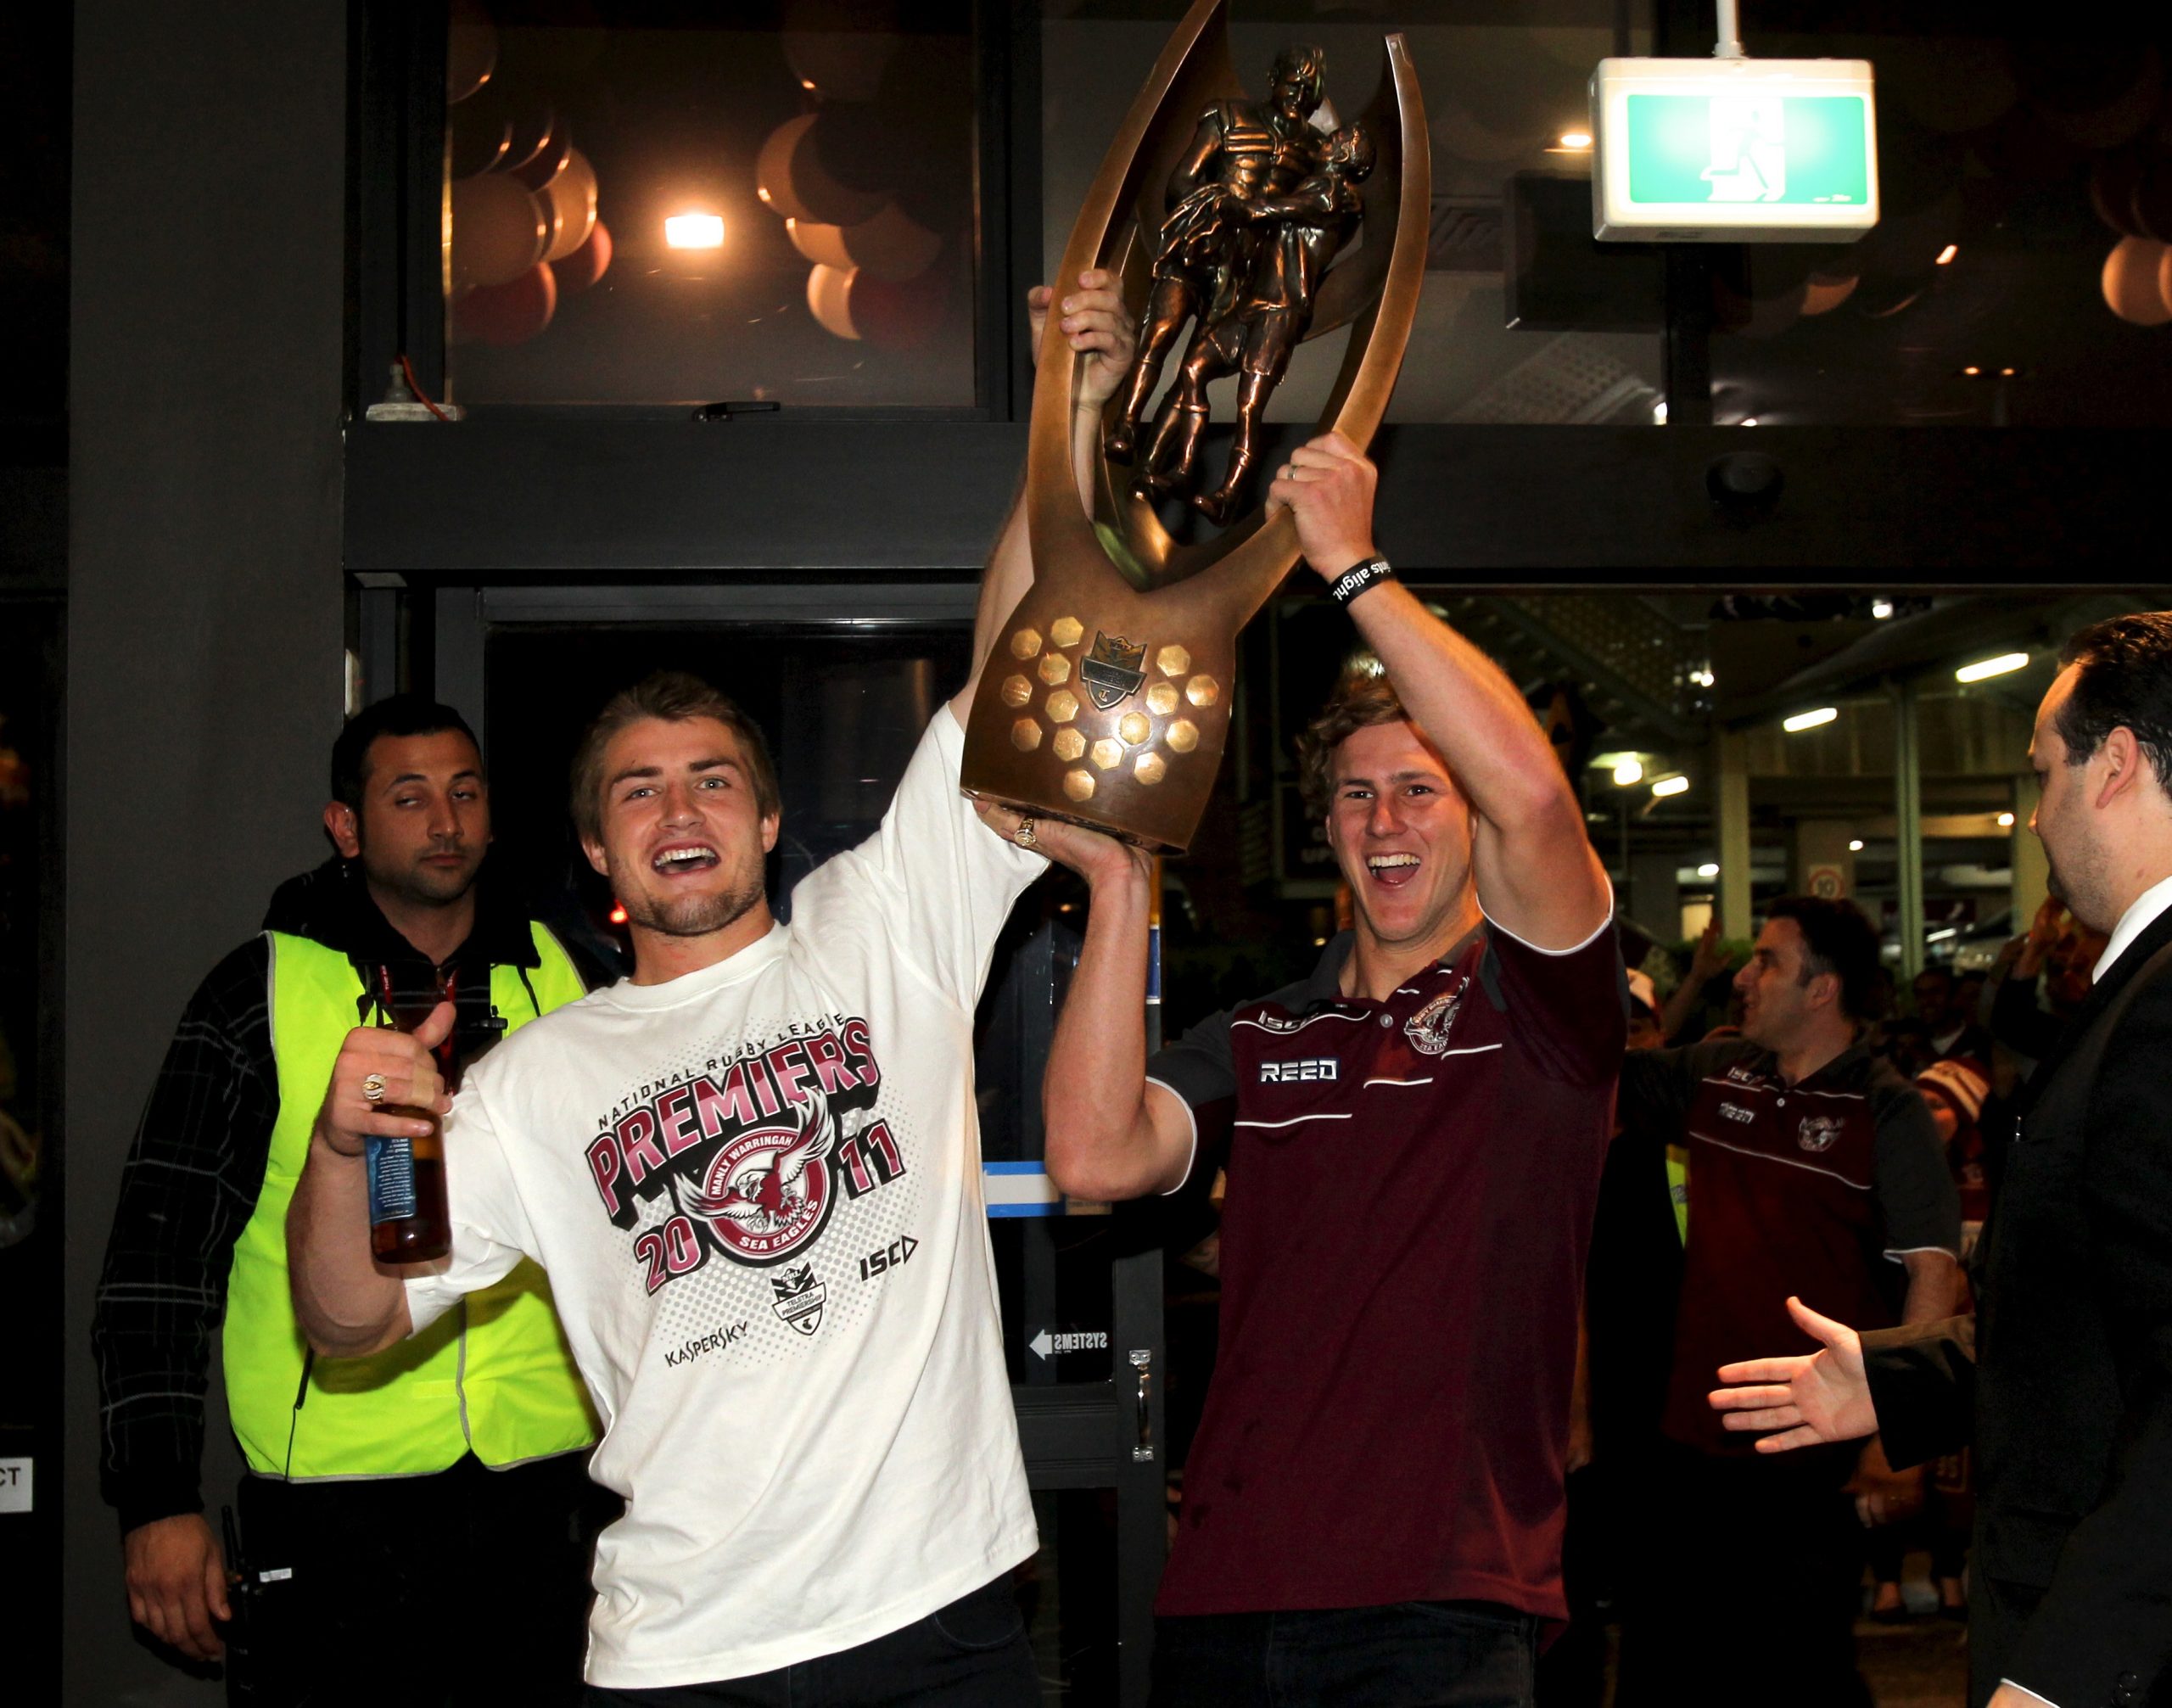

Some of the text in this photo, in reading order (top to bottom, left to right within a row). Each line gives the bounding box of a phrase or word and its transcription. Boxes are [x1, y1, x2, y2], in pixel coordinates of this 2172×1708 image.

[1332, 568, 1371, 601] alight
[1261, 1060, 1337, 1082] REED
[585, 1016, 879, 1218] PREMIERS
[598, 1066, 694, 1128] NATIONAL
[711, 1134, 793, 1196] MANLY WARRINGAH
[636, 1122, 903, 1292] 20 11
[739, 1200, 818, 1250] SEA EAGLES
[787, 1291, 814, 1307] TELSTRA
[665, 1321, 749, 1367] KASPERSKY
